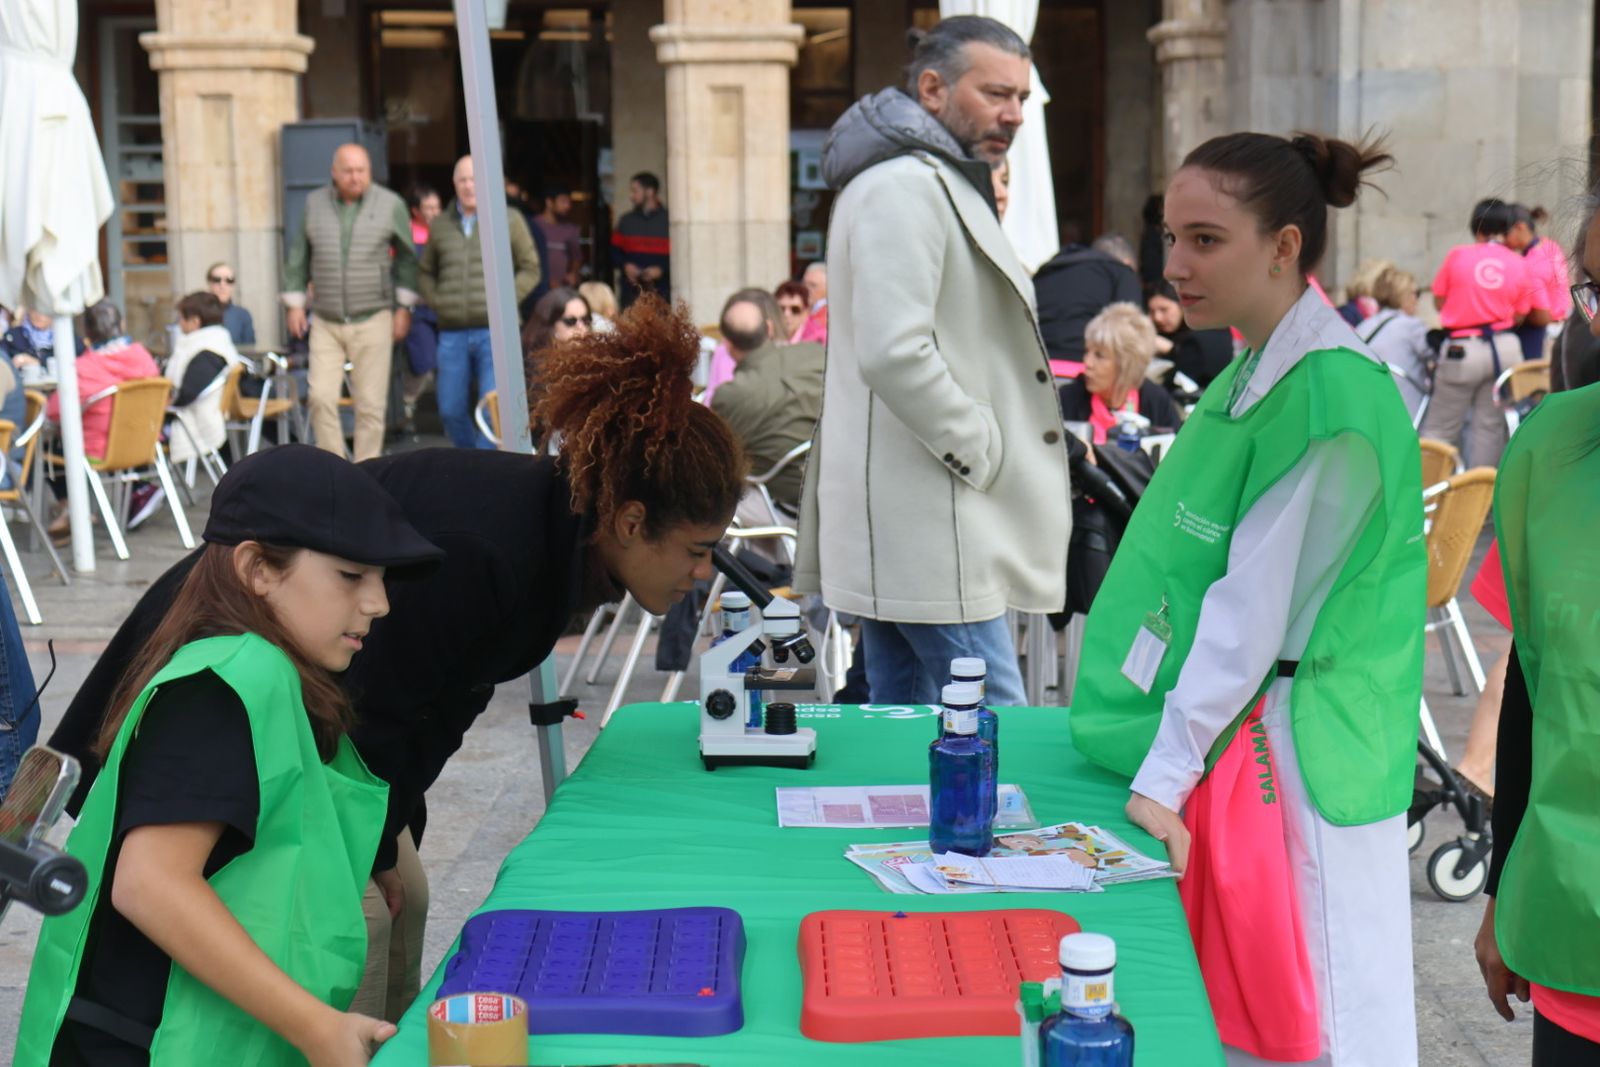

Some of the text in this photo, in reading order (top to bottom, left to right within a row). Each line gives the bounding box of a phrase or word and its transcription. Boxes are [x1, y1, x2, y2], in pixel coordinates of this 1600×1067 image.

[478, 996, 499, 1004] tesa
[478, 1004, 499, 1012] tesa
[478, 1012, 499, 1020] tesa
